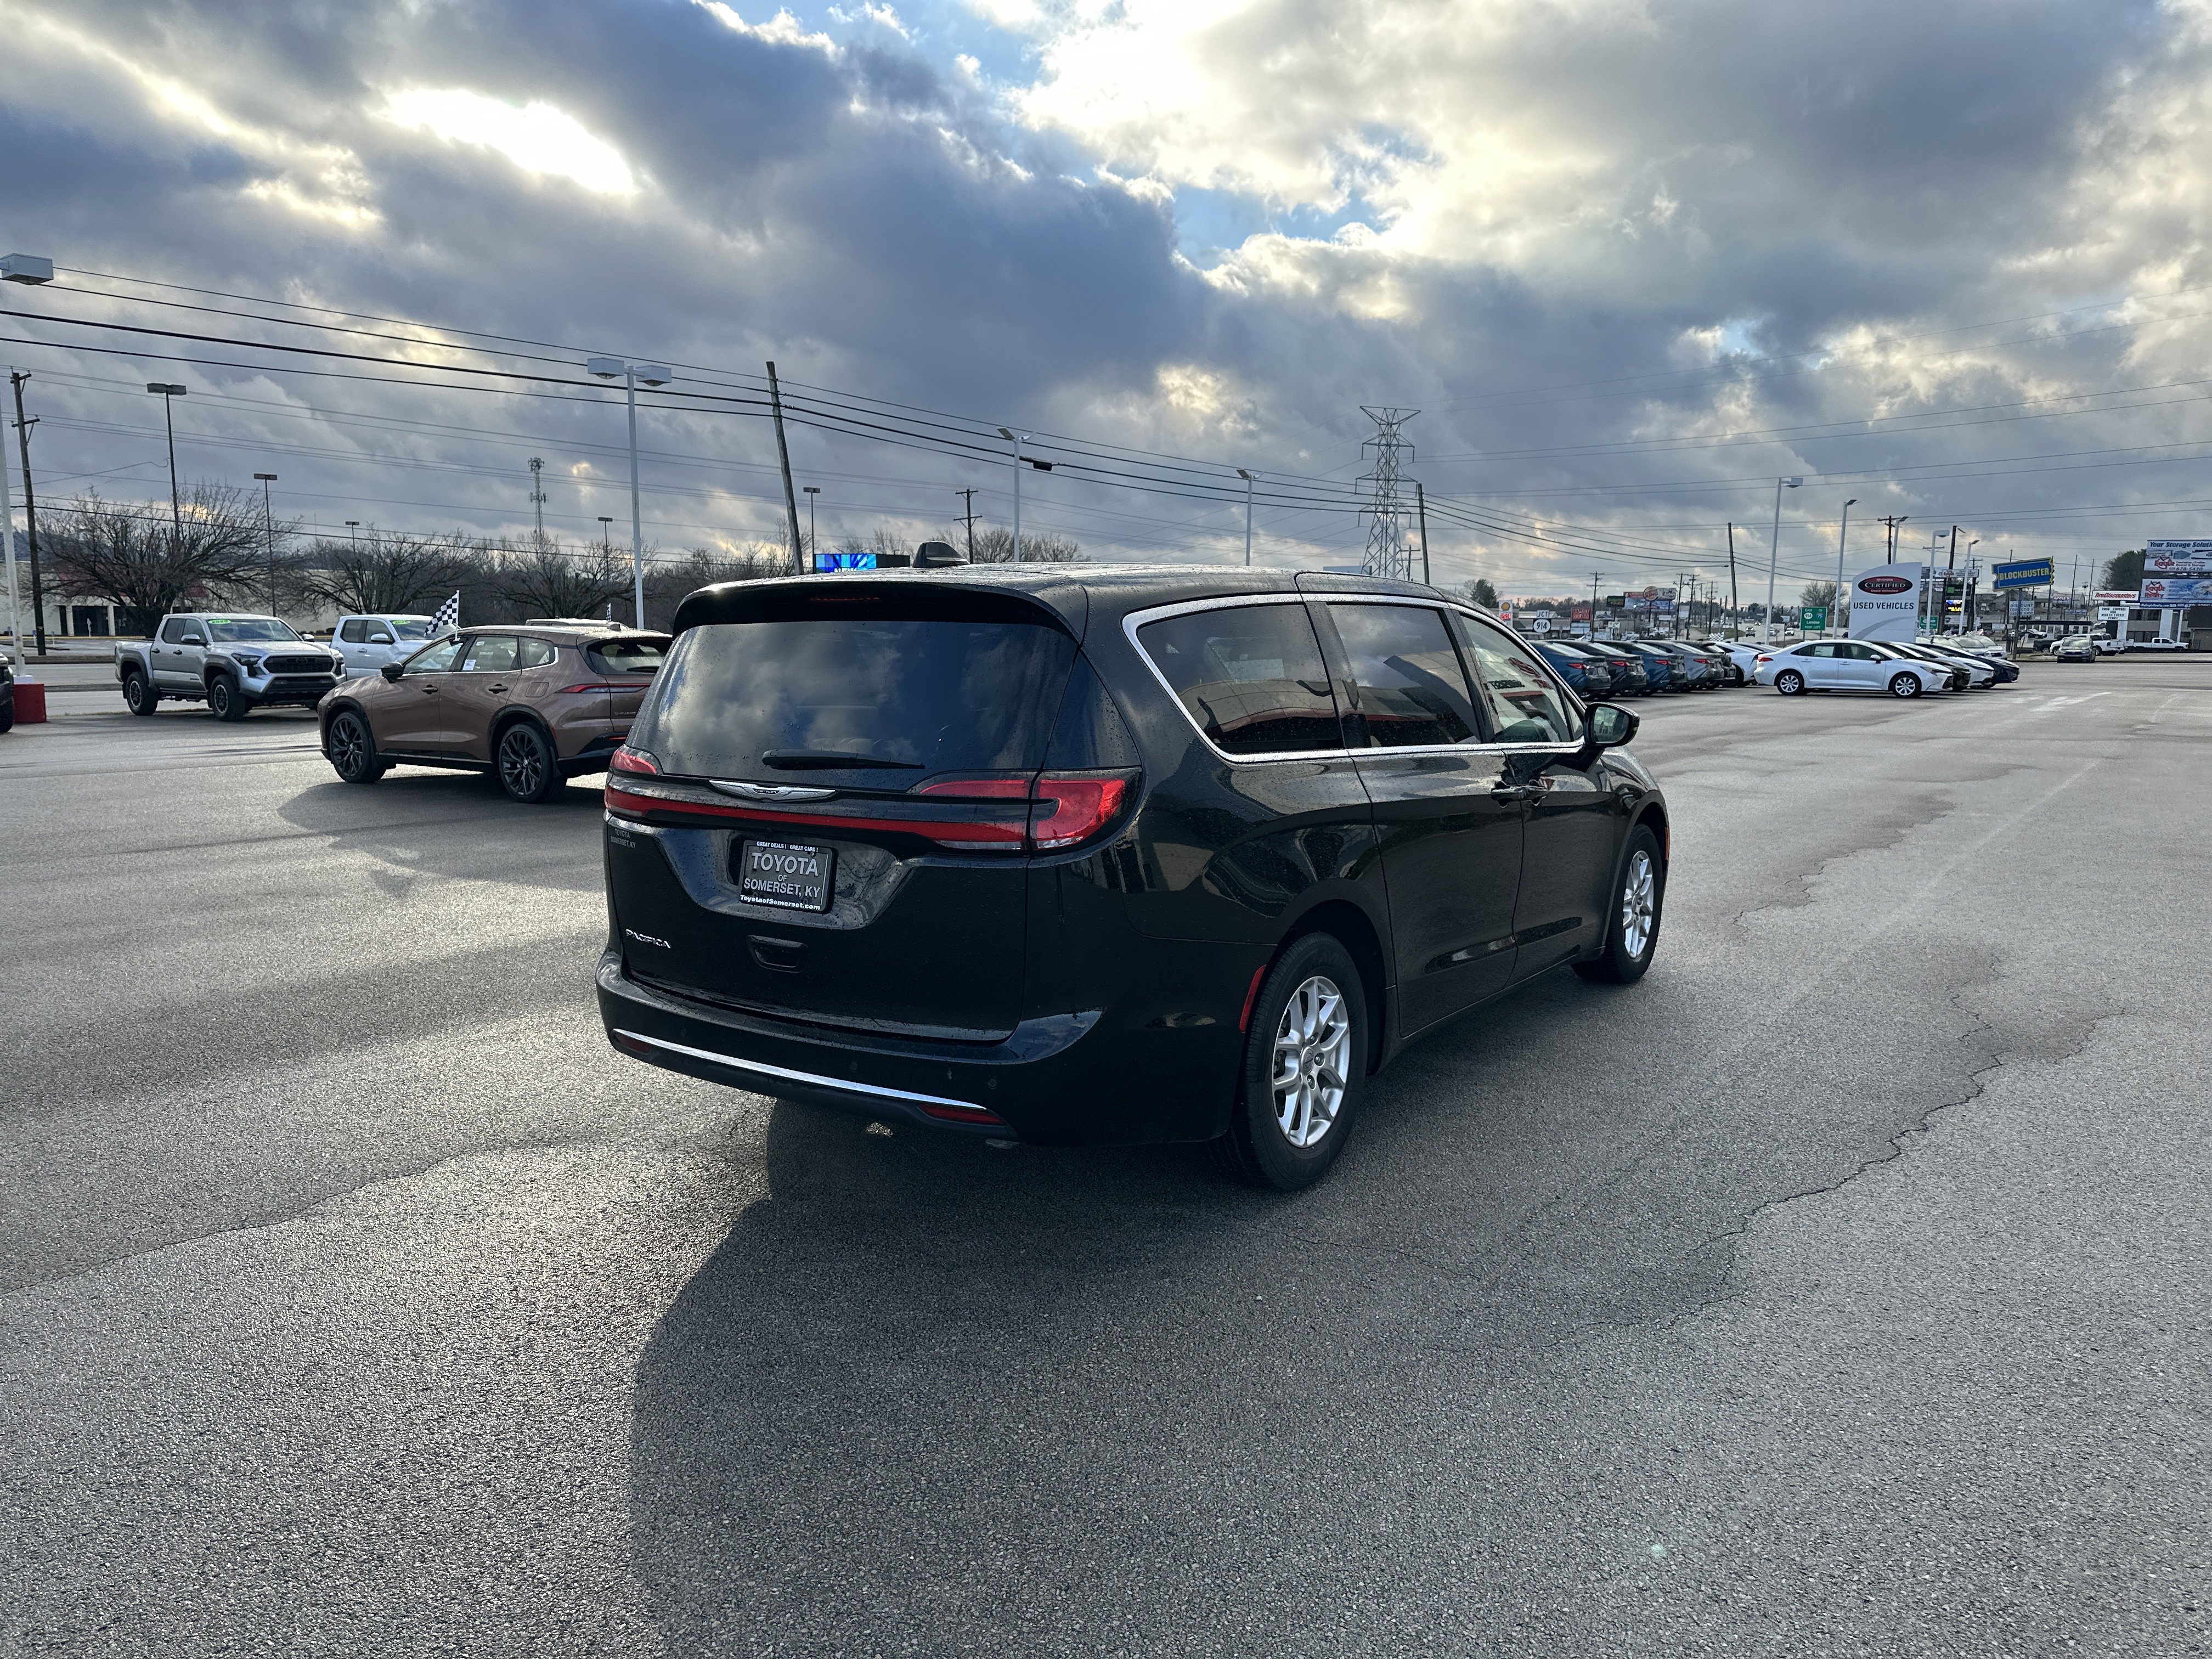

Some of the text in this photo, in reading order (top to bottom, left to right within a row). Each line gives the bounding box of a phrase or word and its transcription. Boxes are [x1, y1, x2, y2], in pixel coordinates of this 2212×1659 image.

[2000, 568, 2049, 580] BLOCKBUSTER
[614, 828, 630, 838] TOYOTA
[610, 836, 630, 848] SOMERSET,
[752, 853, 818, 876] TOYOTA
[743, 878, 820, 898] SOMERSET, KY
[740, 895, 820, 910] ToyotaofSomerset.com
[625, 929, 671, 949] PACIFICA
